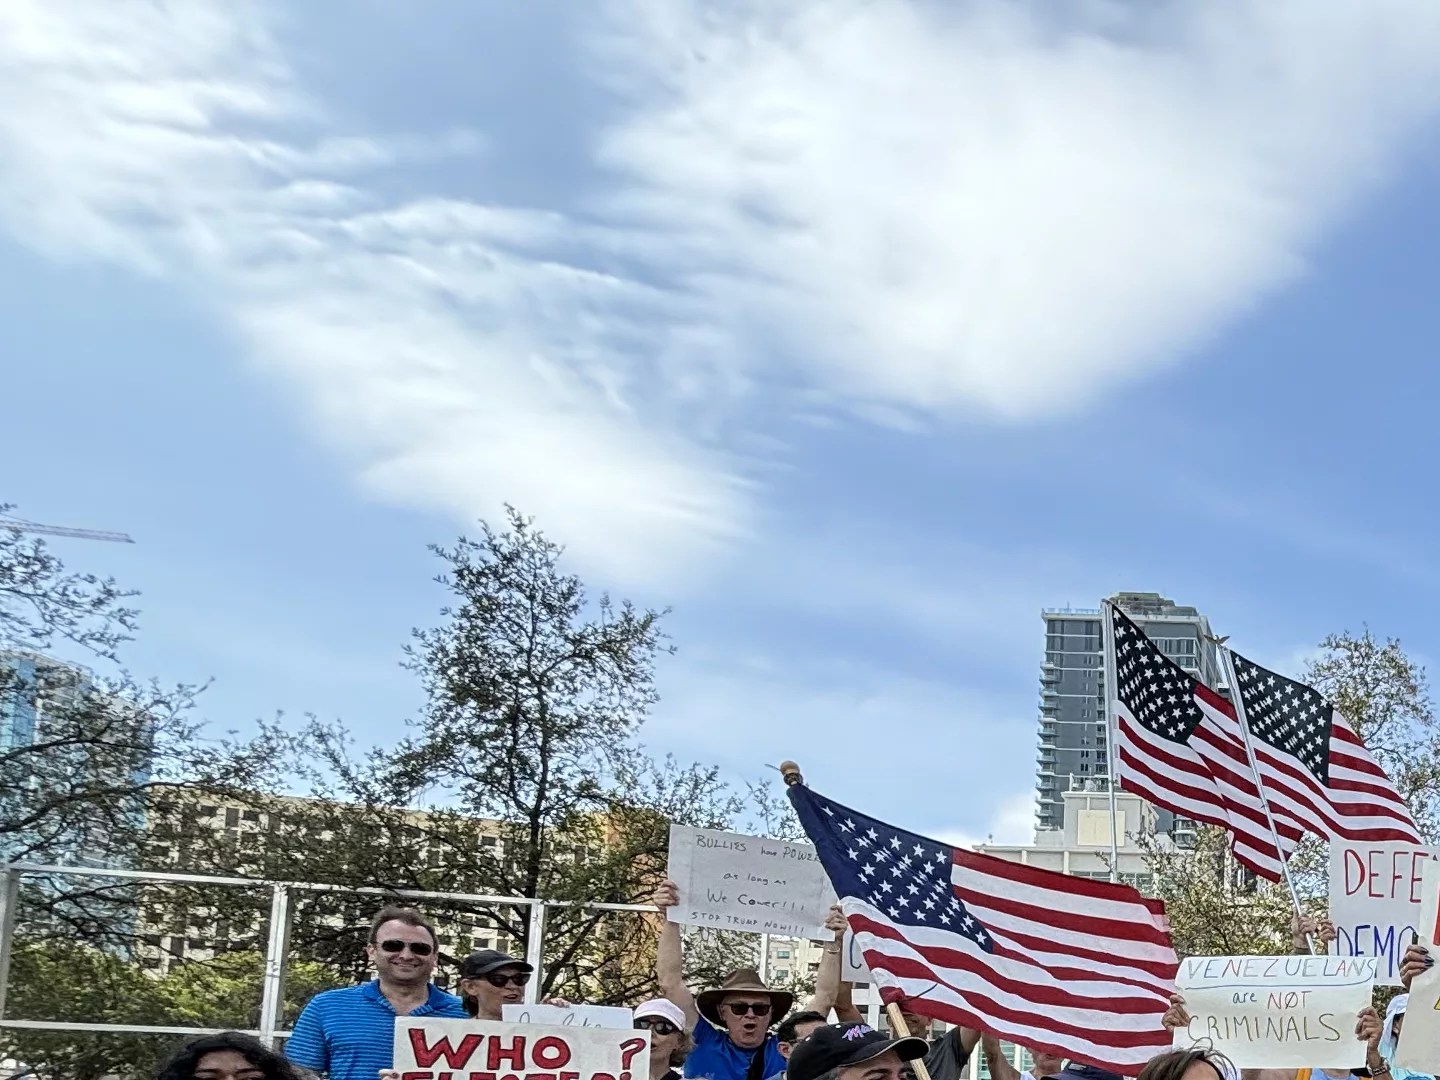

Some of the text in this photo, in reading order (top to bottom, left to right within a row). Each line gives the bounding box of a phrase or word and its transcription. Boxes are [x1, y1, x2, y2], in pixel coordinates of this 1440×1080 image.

[695, 834, 747, 852] BULLIES
[723, 872, 738, 880] as
[747, 872, 769, 886] long
[707, 888, 728, 904] We
[691, 911, 721, 921] STOP
[726, 914, 758, 926] TRUMP
[1187, 958, 1375, 980] VENEZUELANS
[1232, 991, 1257, 1004] are
[1187, 1013, 1341, 1042] CRIMINALS
[408, 1028, 572, 1070] WHO
